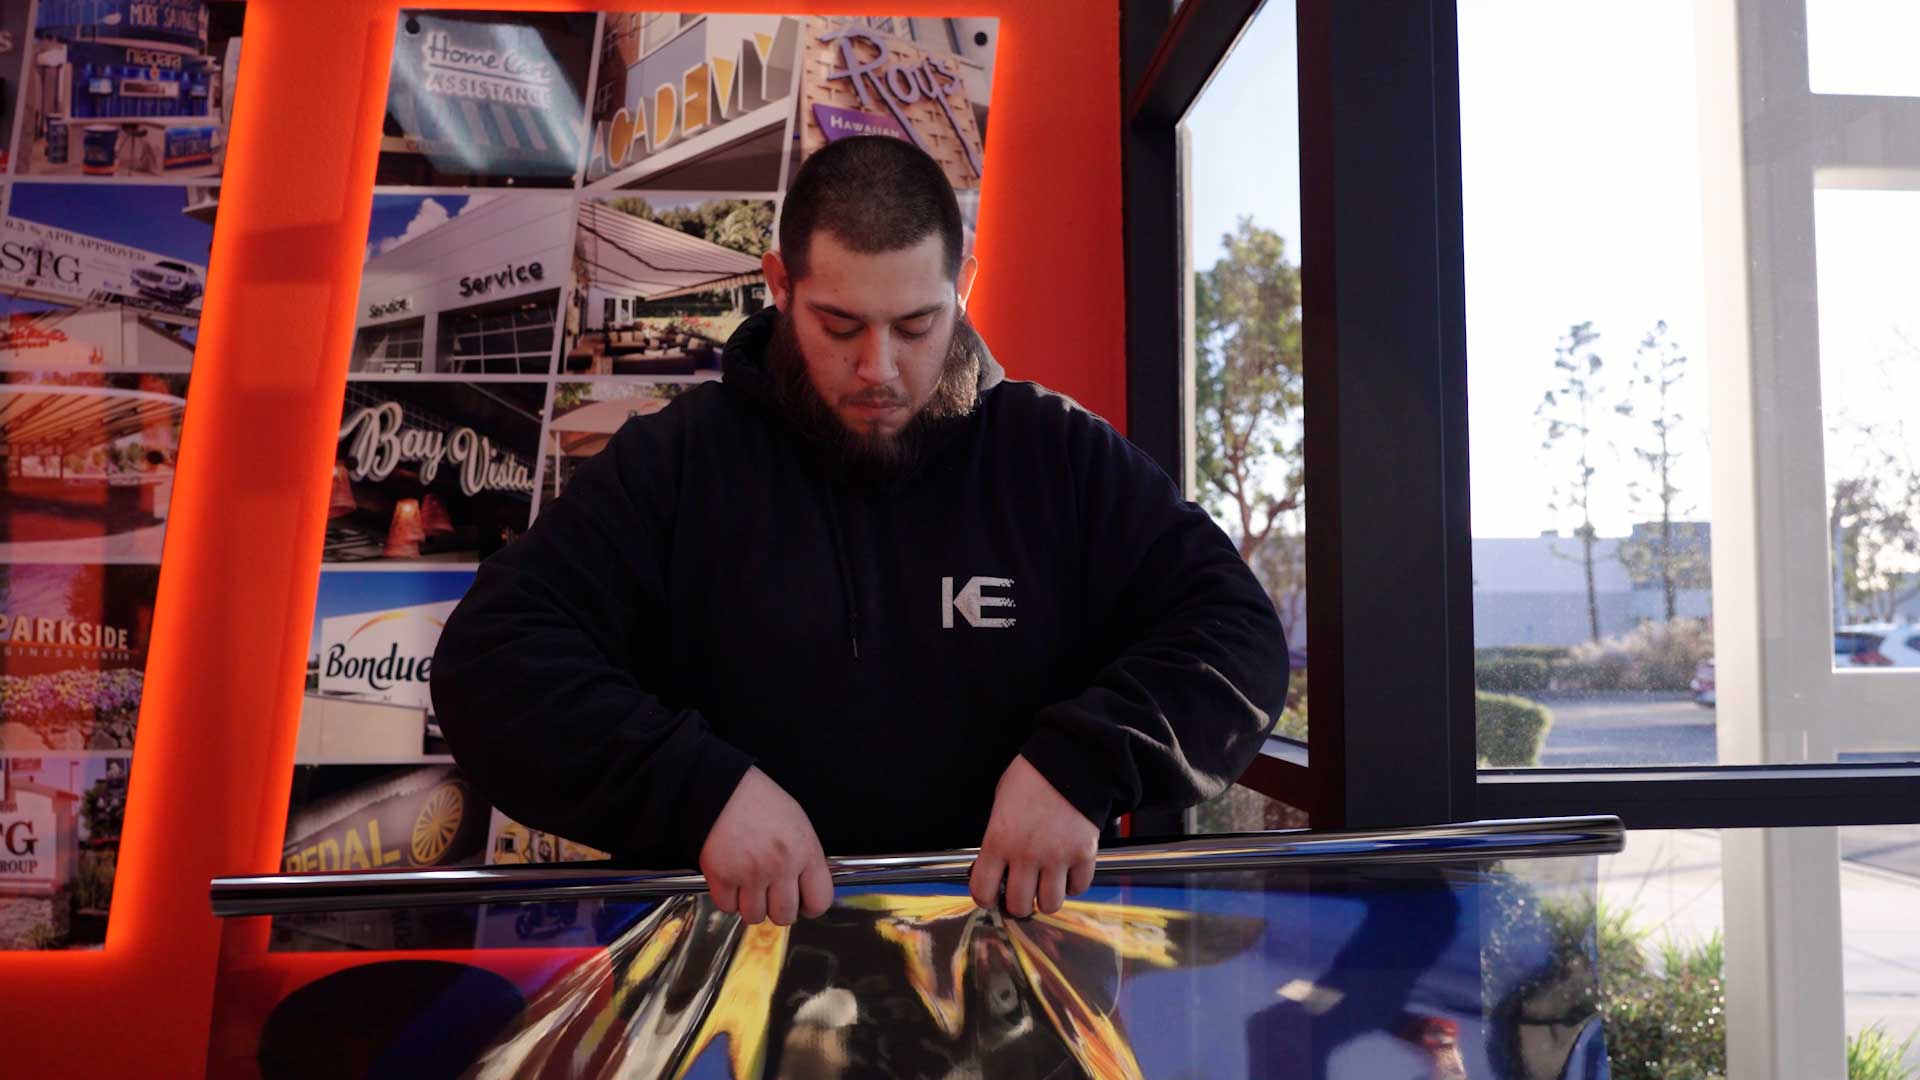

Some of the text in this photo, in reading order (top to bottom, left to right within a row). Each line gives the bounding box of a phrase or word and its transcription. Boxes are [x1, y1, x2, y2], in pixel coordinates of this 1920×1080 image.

[428, 32, 499, 69] Home
[587, 32, 774, 181] ACADEMY
[0, 240, 83, 286] STG
[46, 229, 74, 246] APR
[78, 237, 147, 262] APPROVED
[459, 261, 544, 298] Service
[338, 400, 537, 497] Bay Vista
